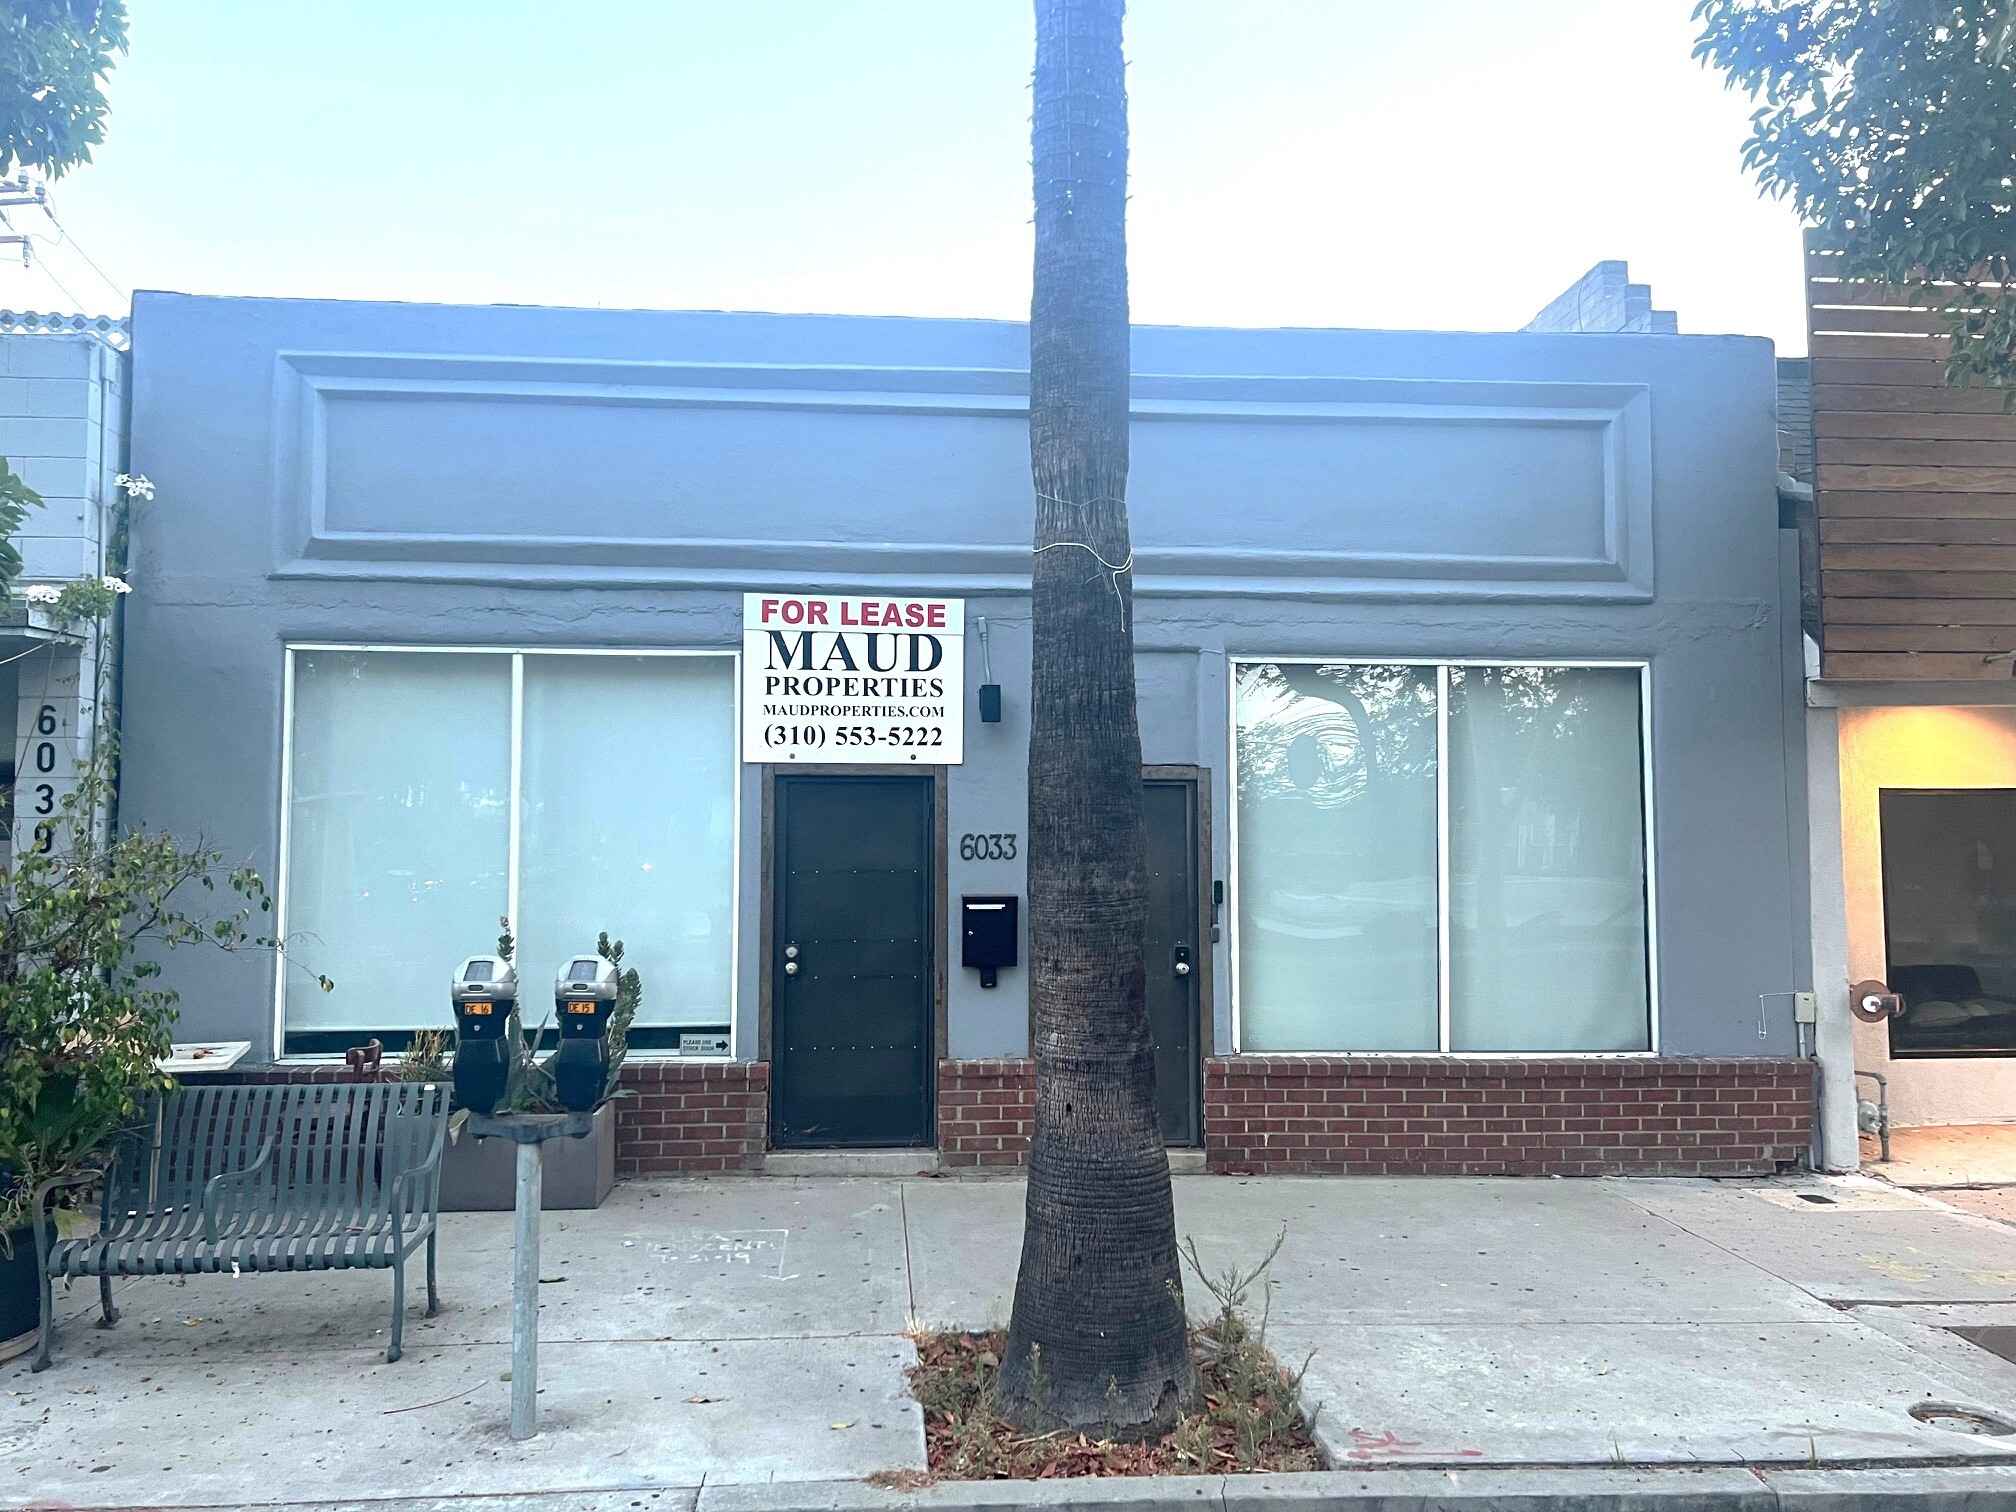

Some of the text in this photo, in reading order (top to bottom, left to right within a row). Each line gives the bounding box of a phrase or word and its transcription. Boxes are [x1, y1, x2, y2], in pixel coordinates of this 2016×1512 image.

[761, 599, 946, 628] FOR LEASE
[763, 630, 943, 672] MAUD
[764, 675, 944, 698] PROPERTIES
[763, 704, 945, 718] MAUDPROPERTIES.COM
[764, 723, 943, 748] (310) 553-5222
[34, 704, 57, 854] 6039
[960, 833, 1018, 861] 6033
[466, 1004, 489, 1015] DE 16
[570, 1003, 590, 1013] DE 15
